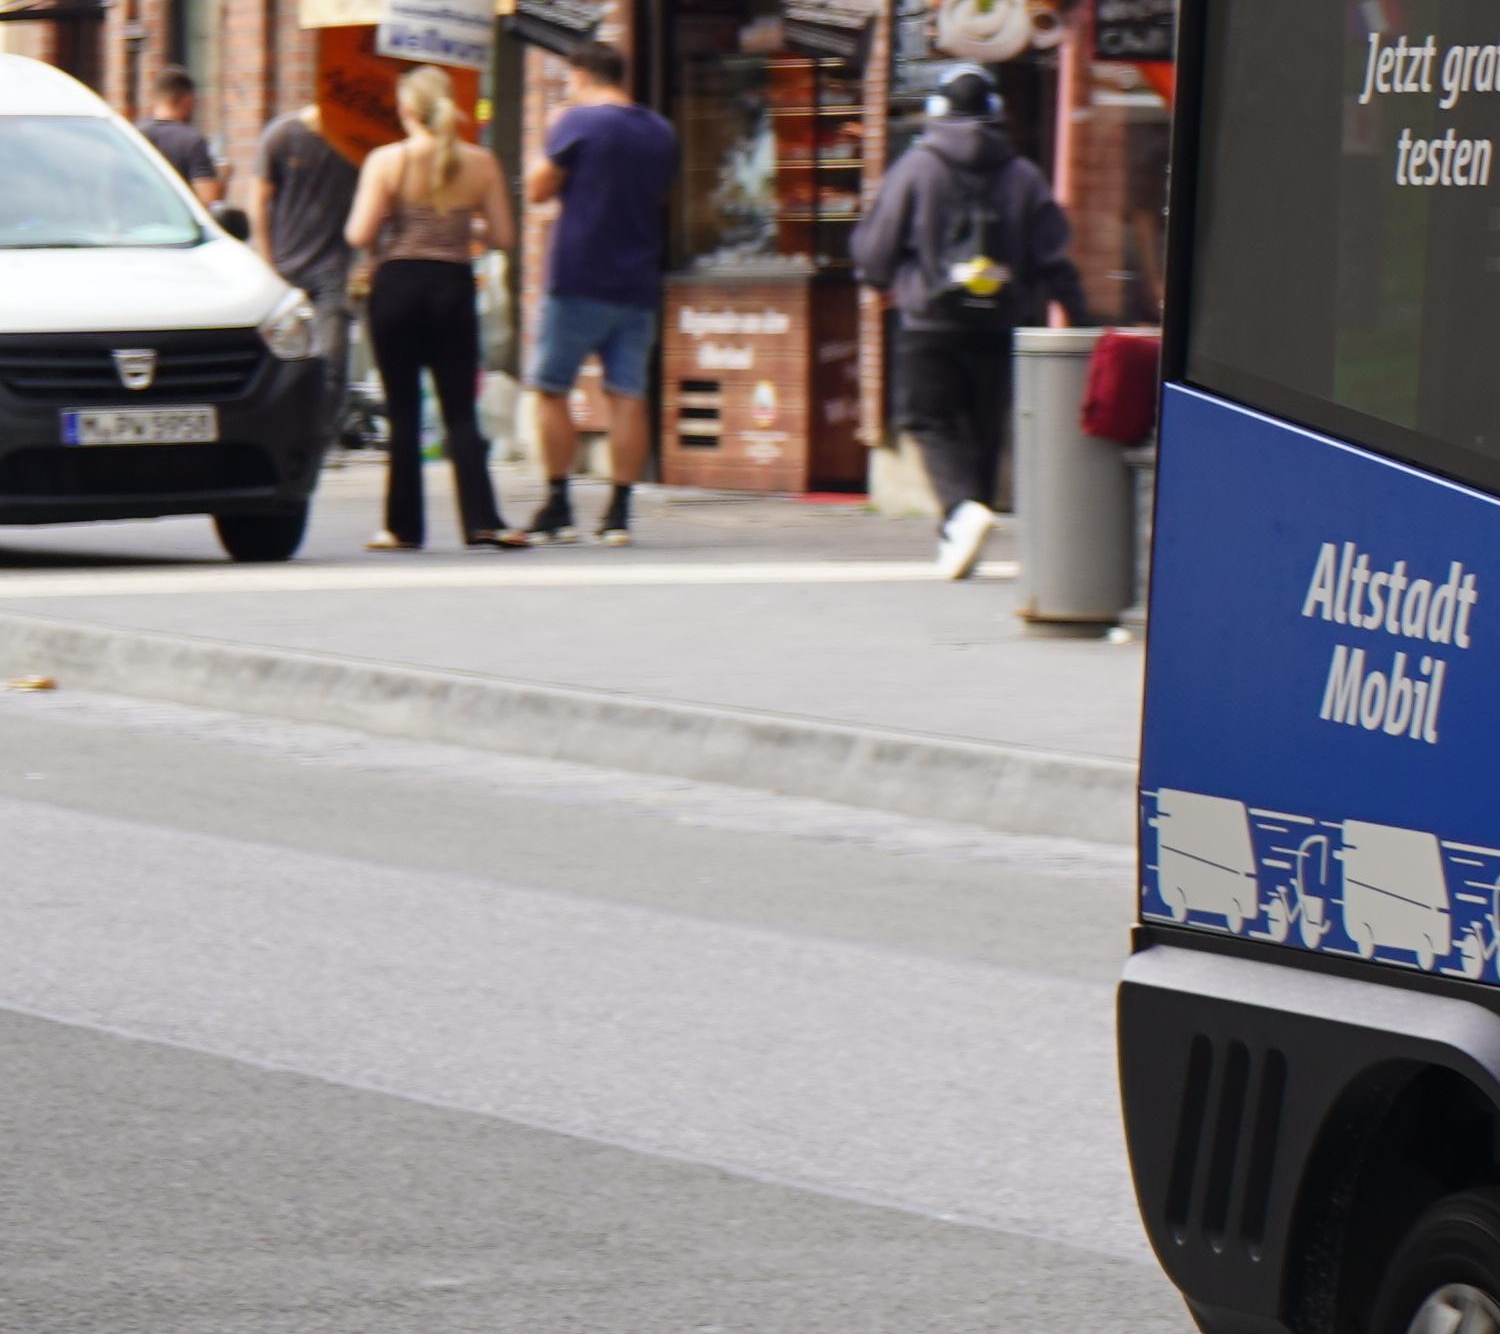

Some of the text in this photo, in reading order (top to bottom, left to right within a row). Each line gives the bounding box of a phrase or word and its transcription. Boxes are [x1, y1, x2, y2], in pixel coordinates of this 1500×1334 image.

[1358, 31, 1436, 105] Jetzt
[1396, 127, 1492, 187] testen
[1302, 541, 1479, 650] Altstadt
[1319, 643, 1448, 745] Mobil
